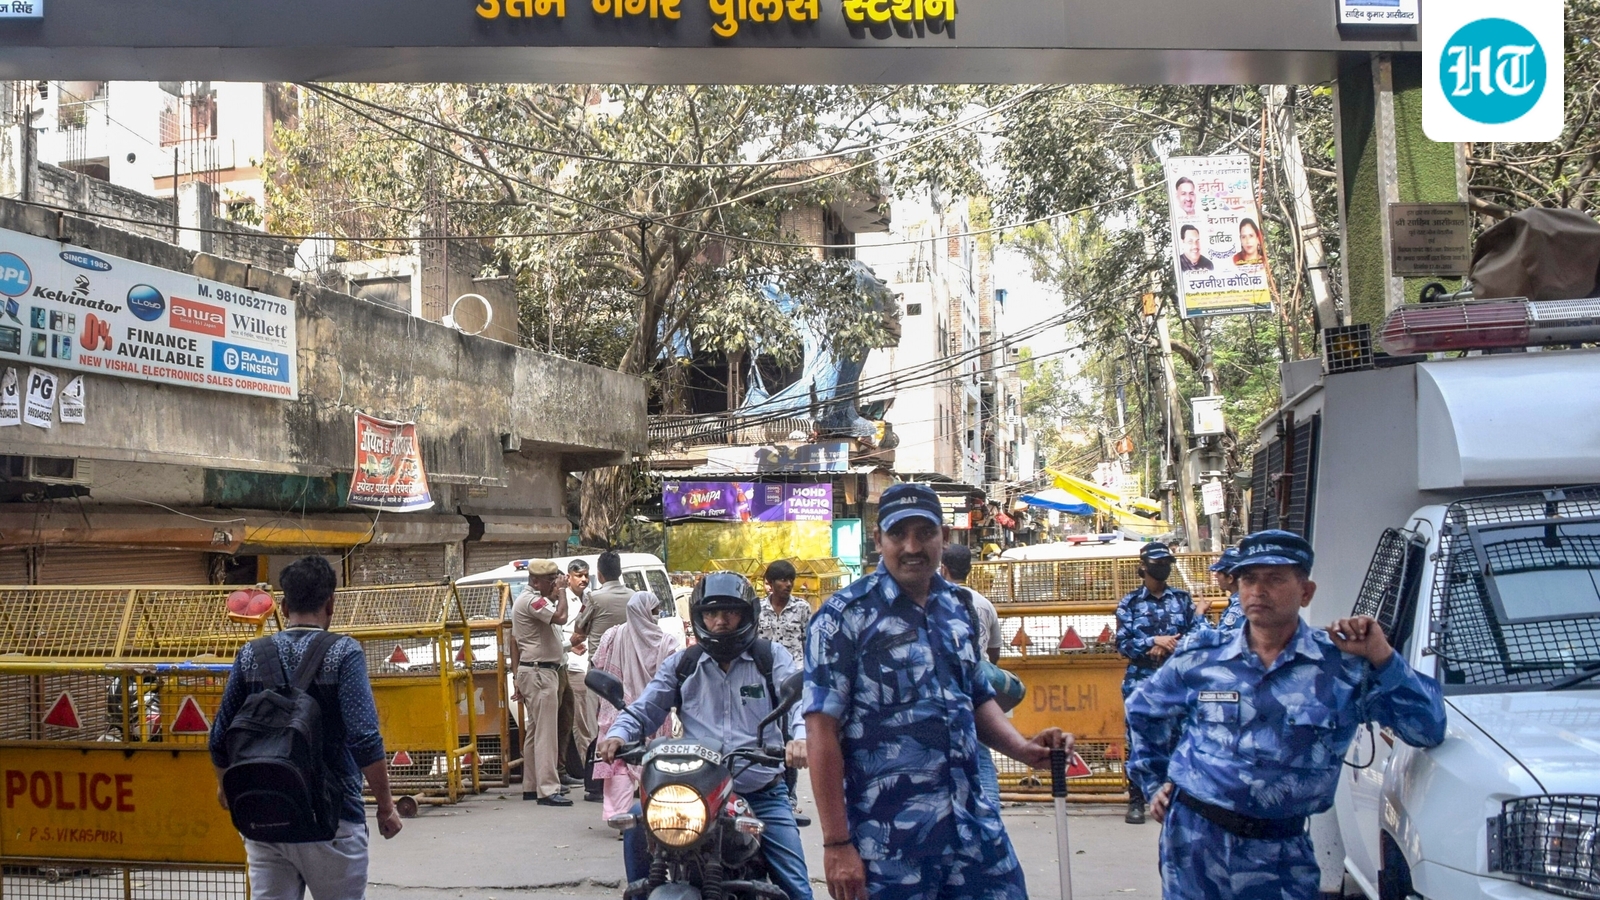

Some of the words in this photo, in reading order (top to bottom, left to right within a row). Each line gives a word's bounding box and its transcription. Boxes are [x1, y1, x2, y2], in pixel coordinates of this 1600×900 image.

[12, 1, 33, 14] सिंह
[1366, 11, 1384, 21] कुमार
[1395, 218, 1405, 226] श्री
[1209, 231, 1232, 245] हार्दिक
[63, 252, 88, 264] SINCE
[90, 259, 109, 270] 1982
[1189, 275, 1225, 290] रजनीश
[1227, 273, 1262, 286] कौशिक
[32, 286, 122, 314] Kelvinator
[131, 298, 162, 310] LLOYD
[198, 284, 213, 298] M.
[216, 288, 287, 316] 9810527778
[171, 305, 224, 324] aiwa
[80, 312, 113, 351] 0%
[203, 321, 217, 329] Japan
[231, 313, 287, 339] Willett
[127, 327, 197, 351] FINANCE
[117, 342, 204, 368] AVAILABLE
[241, 351, 279, 365] BAJAJ
[79, 354, 102, 367] NEW
[105, 358, 139, 374] VISHAL
[142, 364, 204, 383] ELECTRONICS
[206, 374, 233, 387] SALES
[235, 378, 292, 396] CORPORATION
[241, 363, 279, 376] FINSERV
[30, 374, 53, 399] PG
[792, 487, 826, 497] MOHD
[788, 498, 829, 508] TAUFIQ
[901, 496, 917, 504] RAF
[1248, 543, 1273, 556] RAF
[1033, 684, 1098, 712] DELHI
[663, 745, 690, 753] 9SCH
[5, 769, 135, 812] POLICE
